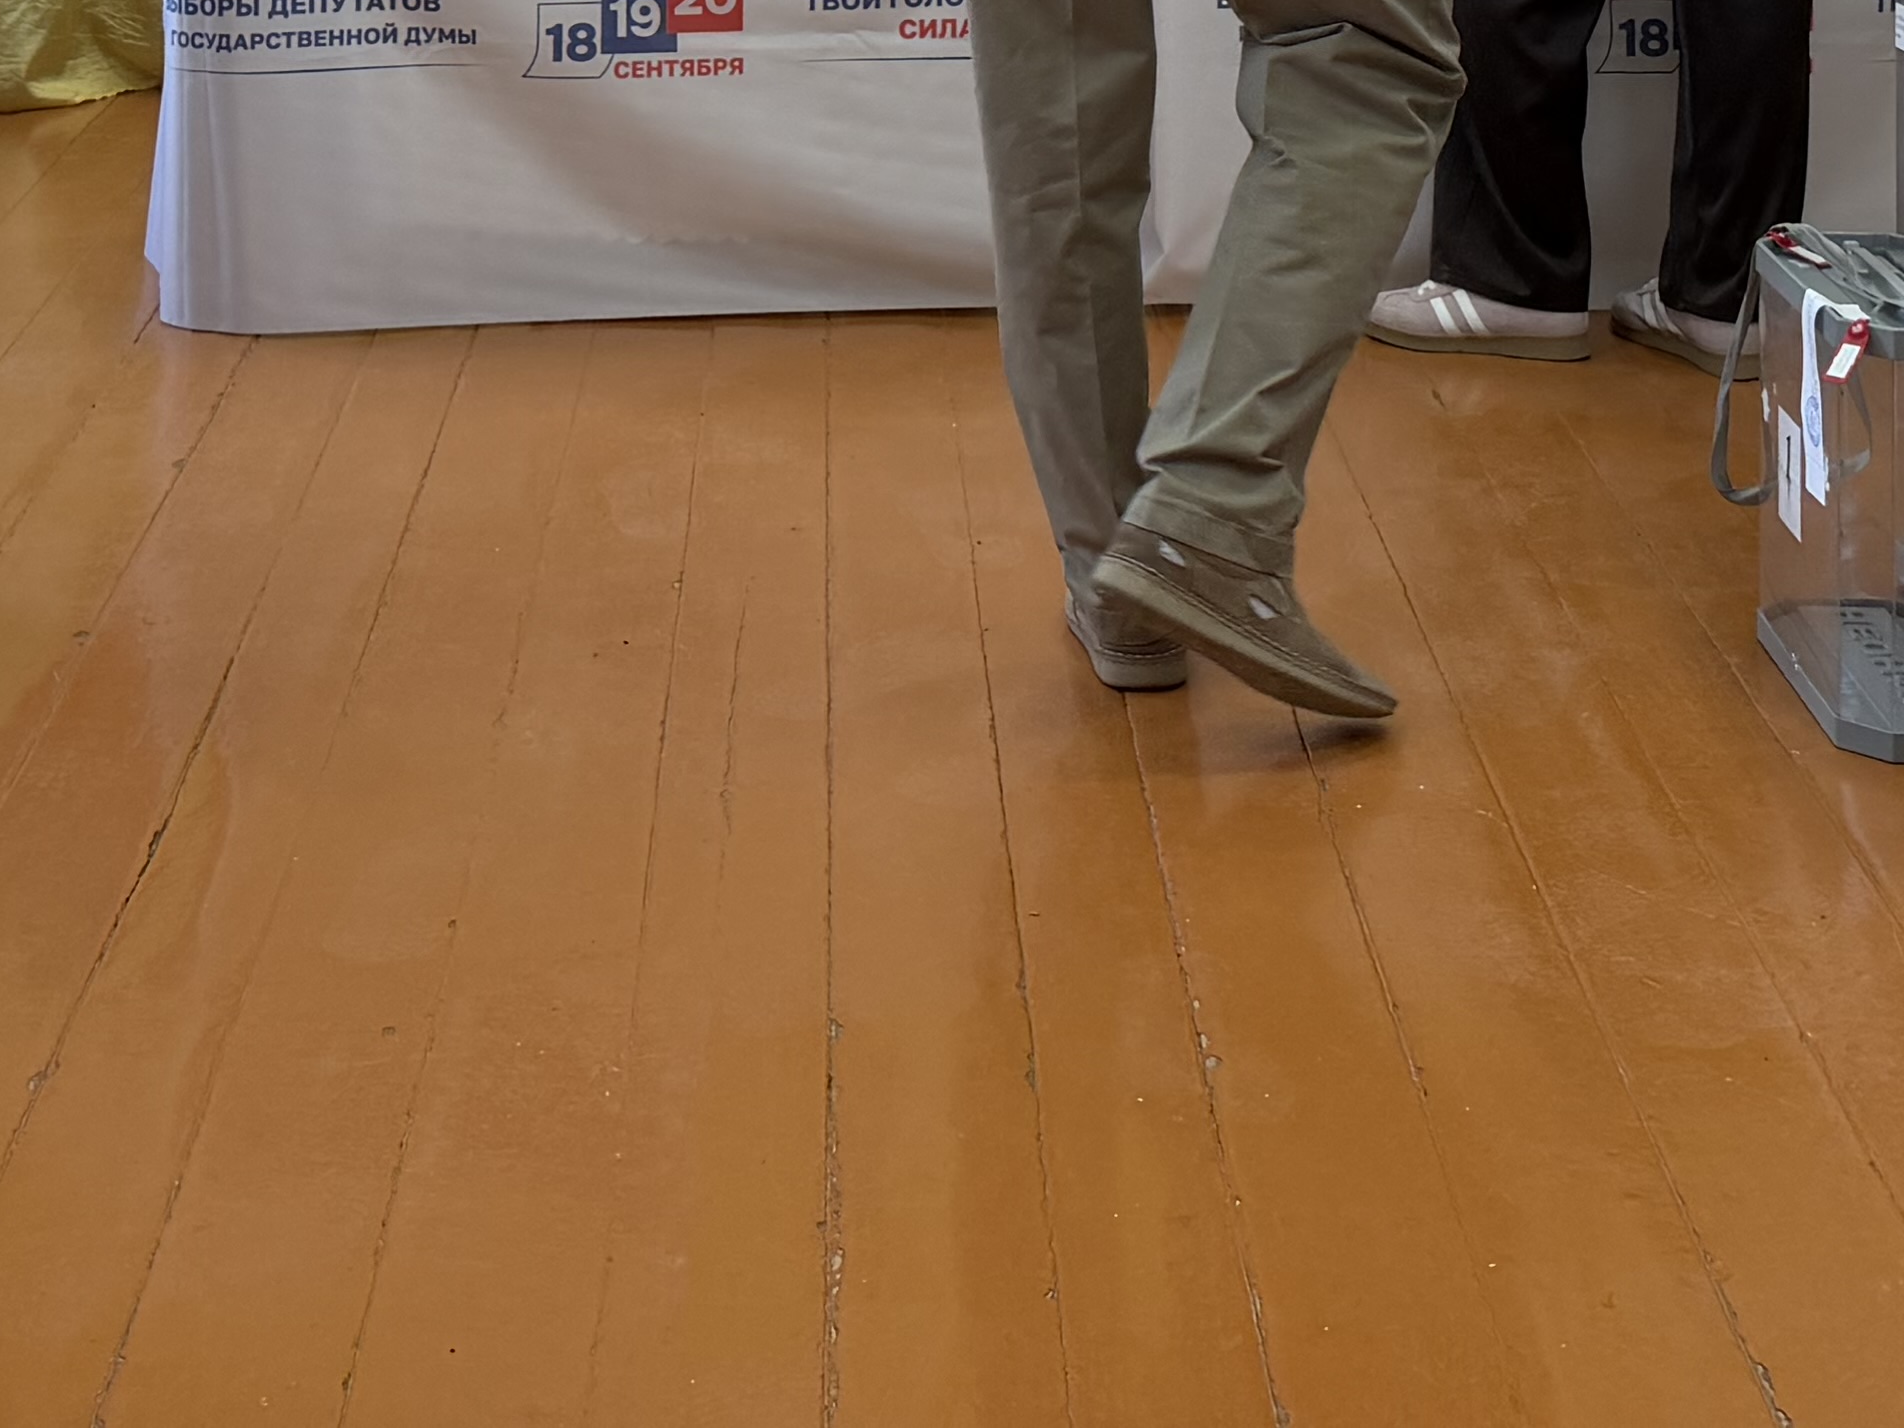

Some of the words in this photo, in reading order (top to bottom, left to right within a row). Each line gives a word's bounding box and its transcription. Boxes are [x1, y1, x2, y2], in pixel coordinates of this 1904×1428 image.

[171, 22, 398, 53] ГОСУДАРСТВЕННОЙ
[404, 26, 478, 46] ДУМЫ
[545, 22, 597, 63] 18
[1618, 18, 1669, 58] 18
[613, 57, 745, 79] СЕНТЯБРЯ
